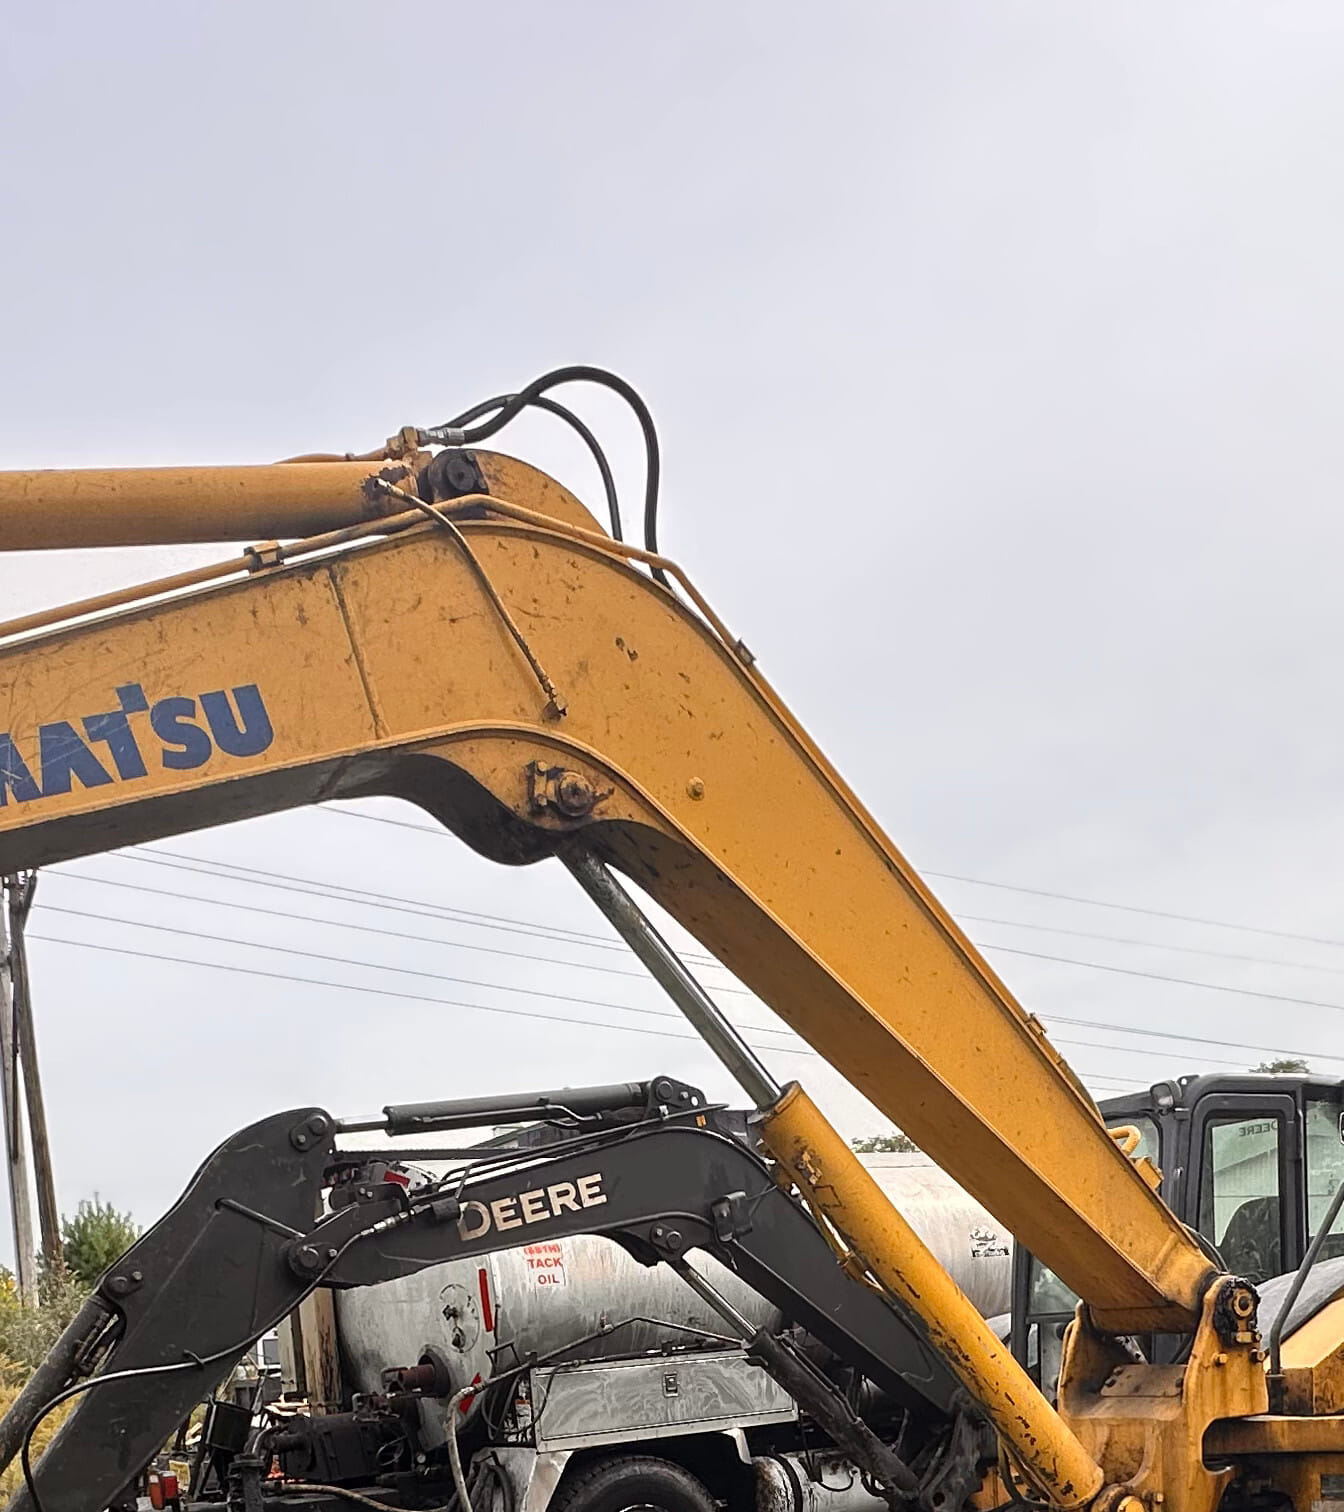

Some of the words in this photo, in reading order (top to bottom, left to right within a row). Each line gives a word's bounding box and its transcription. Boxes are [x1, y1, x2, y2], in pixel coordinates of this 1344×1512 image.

[456, 1173, 607, 1241] DEERE
[527, 1257, 563, 1269] TACK
[537, 1273, 560, 1285] OIL
